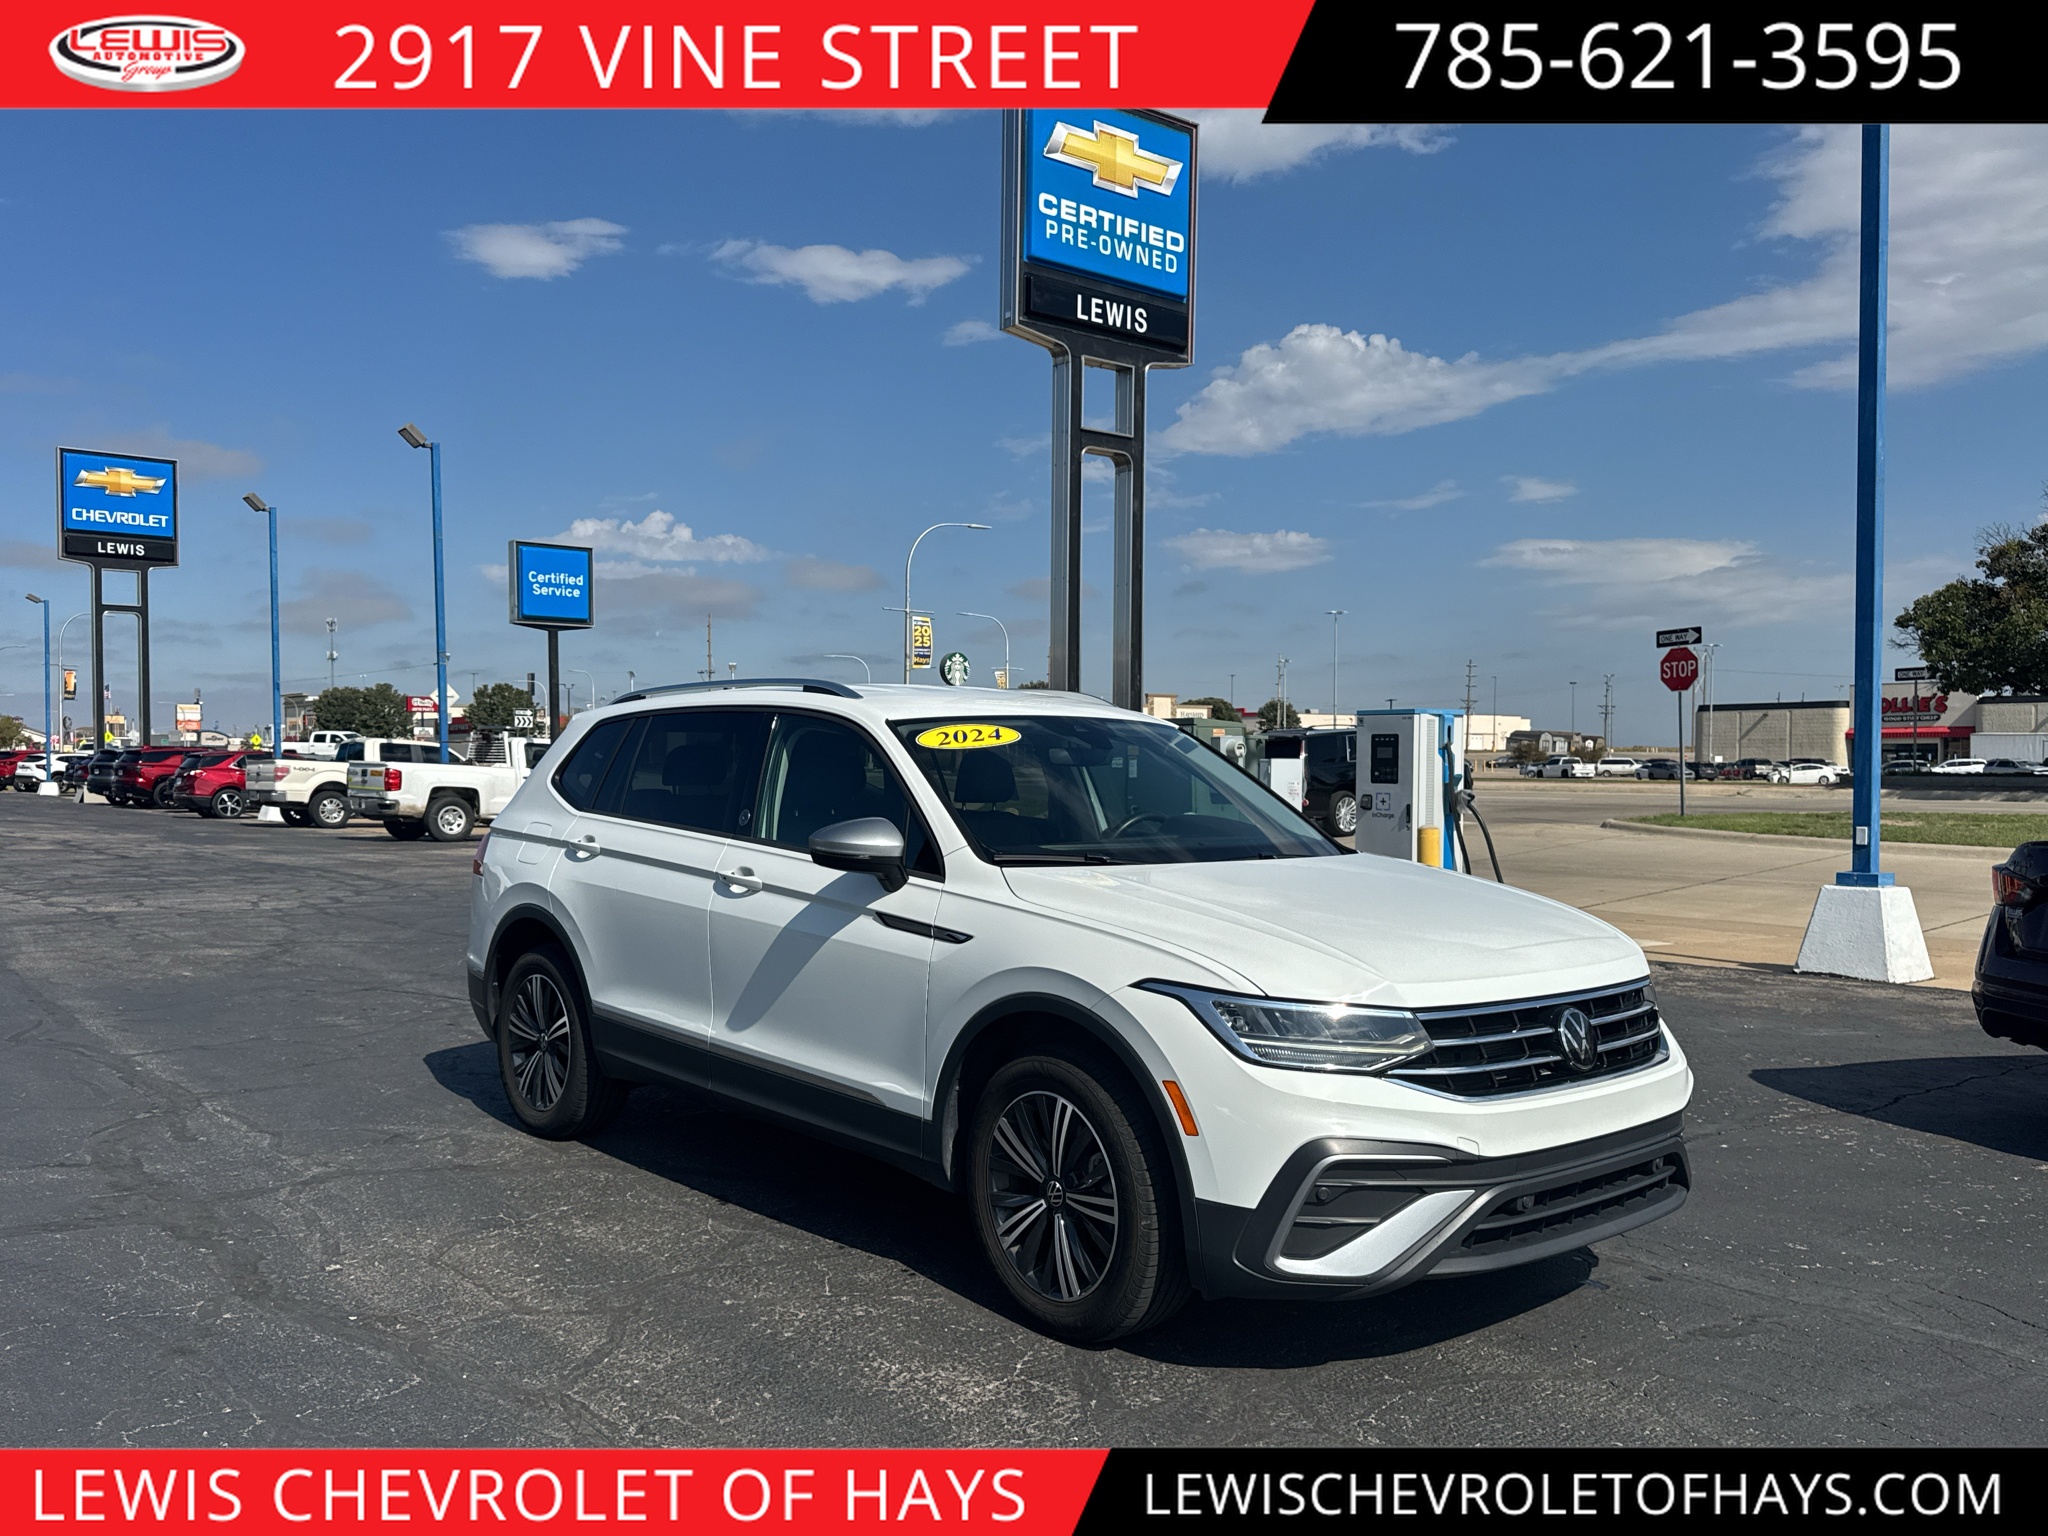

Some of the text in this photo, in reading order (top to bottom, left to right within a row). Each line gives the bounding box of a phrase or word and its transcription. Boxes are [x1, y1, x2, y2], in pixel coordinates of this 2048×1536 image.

[1038, 192, 1185, 253] CERTIFIED
[1046, 219, 1177, 273] PRE-OWNED
[1076, 294, 1148, 333] LEWIS
[71, 508, 169, 527] CHEVROLET
[97, 541, 145, 556] LEWIS
[528, 570, 583, 586] Certified
[532, 584, 581, 597] Service
[914, 625, 930, 637] 20
[914, 636, 931, 647] 25
[1662, 660, 1696, 679] STOP
[936, 728, 1002, 746] 2024
